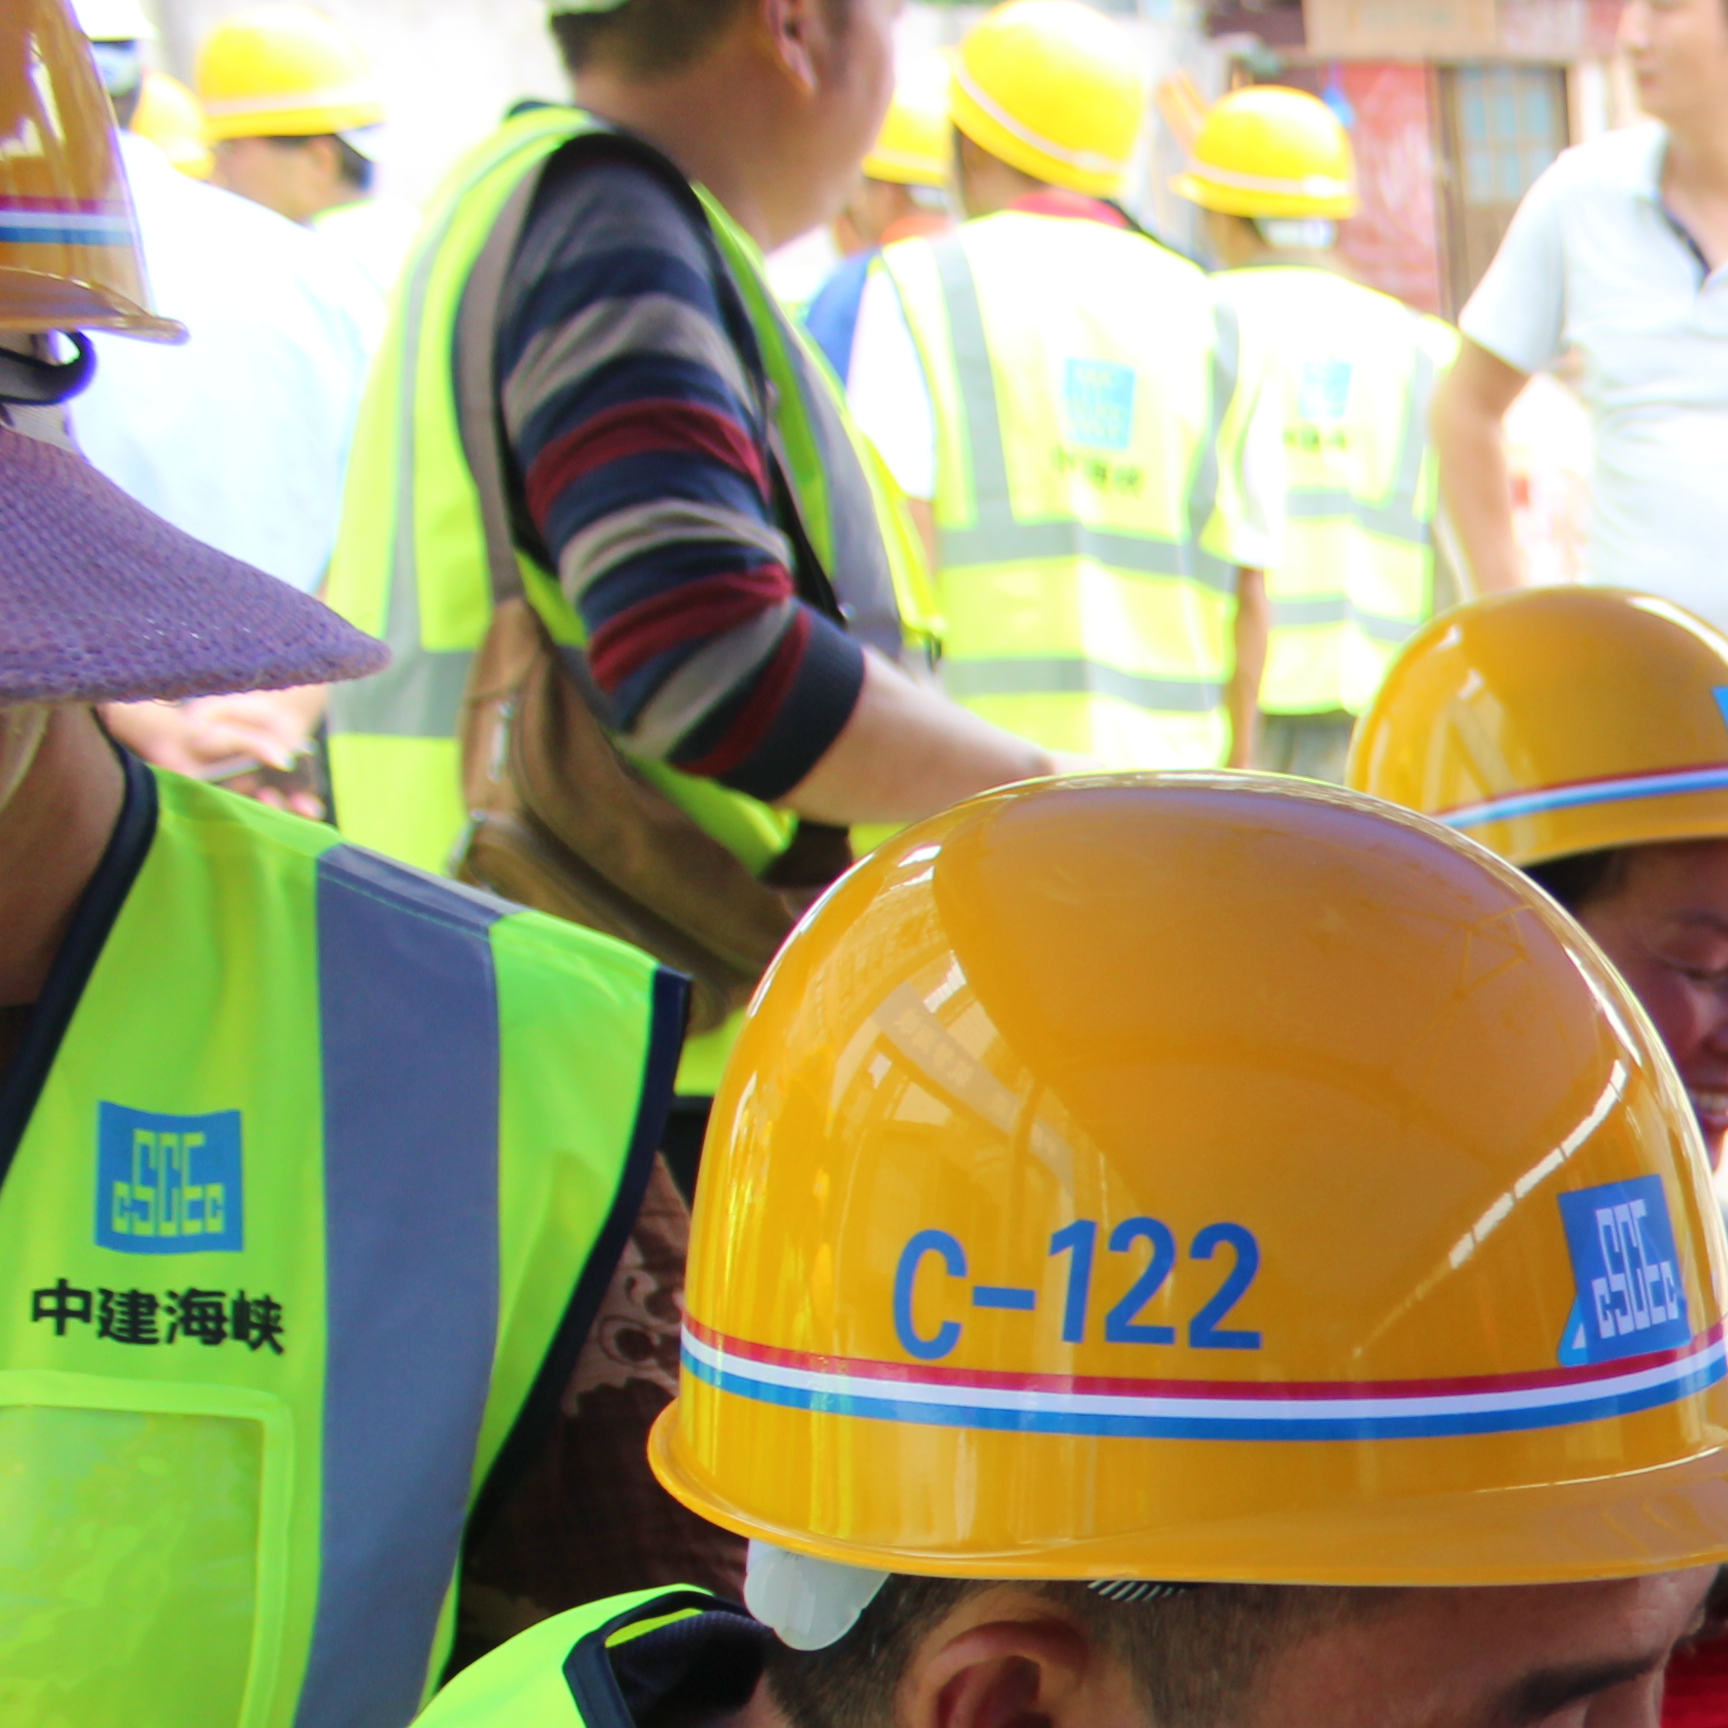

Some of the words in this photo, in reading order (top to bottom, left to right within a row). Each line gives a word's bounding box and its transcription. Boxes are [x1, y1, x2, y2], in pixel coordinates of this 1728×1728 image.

[30, 1277, 286, 1356] 中建海峡
[893, 1215, 1263, 1361] C-122
